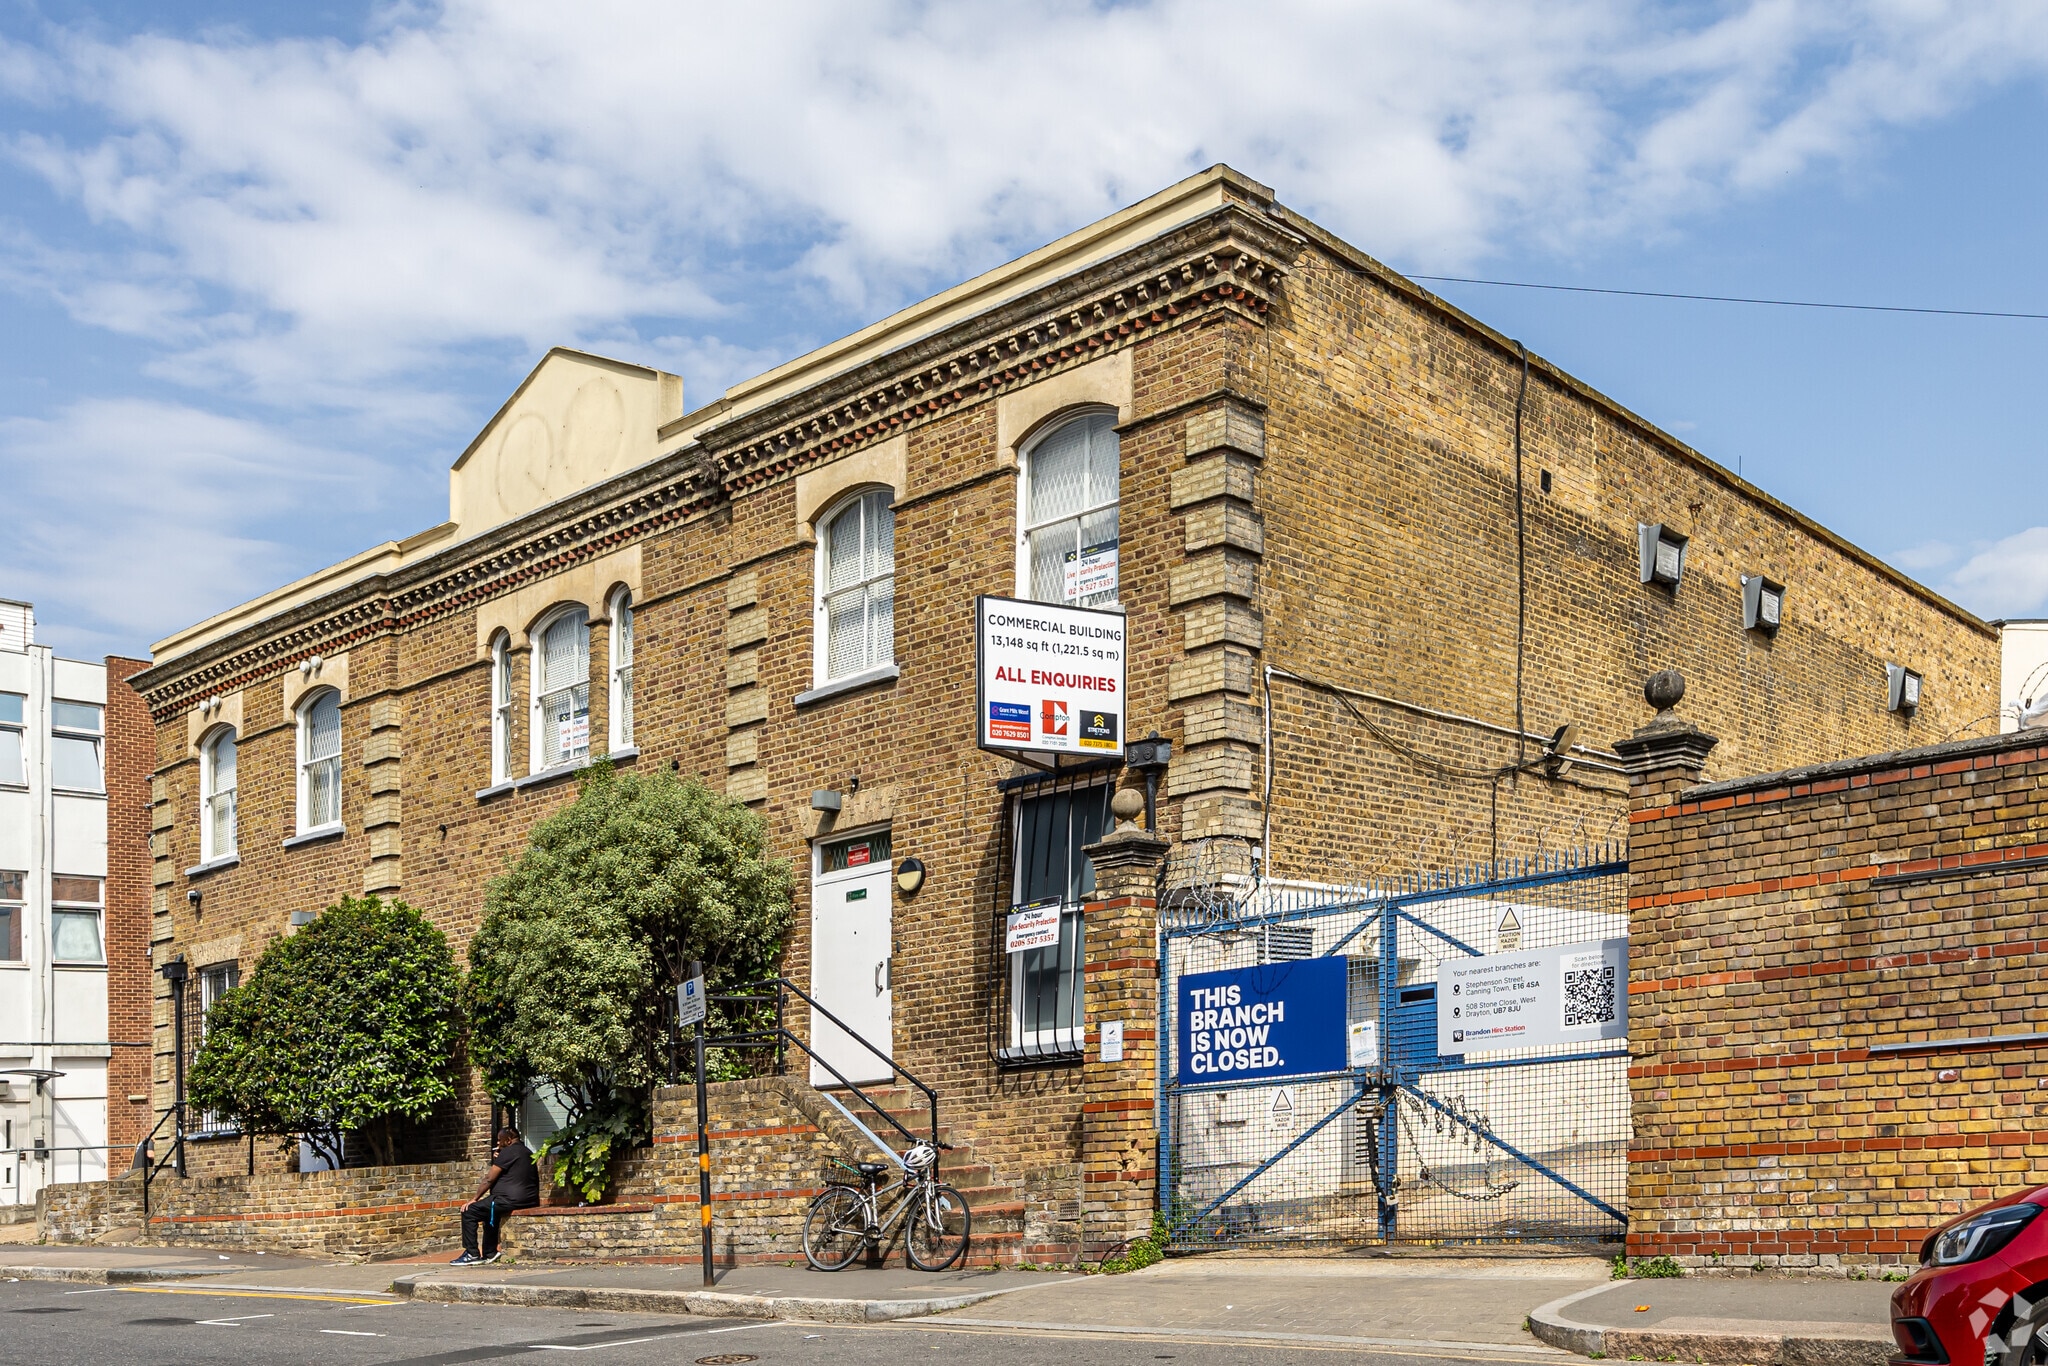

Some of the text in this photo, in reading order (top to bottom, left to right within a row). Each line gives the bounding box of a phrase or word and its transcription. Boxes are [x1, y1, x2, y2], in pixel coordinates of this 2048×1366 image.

[1089, 557, 1101, 565] hour
[1094, 561, 1116, 571] Protection
[1094, 573, 1108, 581] contact
[1068, 577, 1114, 595] 028 527 5357
[988, 614, 1121, 641] COMMERCIAL BUILDING
[991, 635, 1119, 661] 13,148 sq ft (1,221.5 sq m)
[995, 666, 1116, 692] ALL ENQUIRIES
[1040, 711, 1070, 721] Compton
[1017, 731, 1029, 739] 8501
[1018, 920, 1035, 930] Security
[1036, 917, 1057, 926] Protection
[1010, 933, 1054, 948] 0208 527 5357
[1016, 931, 1035, 939] Emergency
[1469, 966, 1494, 975] nearest
[1495, 962, 1526, 972] branches
[1528, 960, 1541, 968] are:
[1580, 960, 1607, 968] directions
[1465, 987, 1491, 996] Canning
[1493, 985, 1511, 993] Town,
[1512, 982, 1524, 990] E16
[1466, 976, 1525, 989] Stephenson Street,
[1190, 985, 1241, 1010] THIS
[1466, 996, 1536, 1010] 508 Stone Close, West
[1190, 1001, 1284, 1031] BRANCH
[1466, 1008, 1491, 1018] Drayton,
[1508, 1005, 1521, 1013] 8JU
[1191, 1025, 1270, 1053] IS NOW
[1191, 1047, 1285, 1074] CLOSED.
